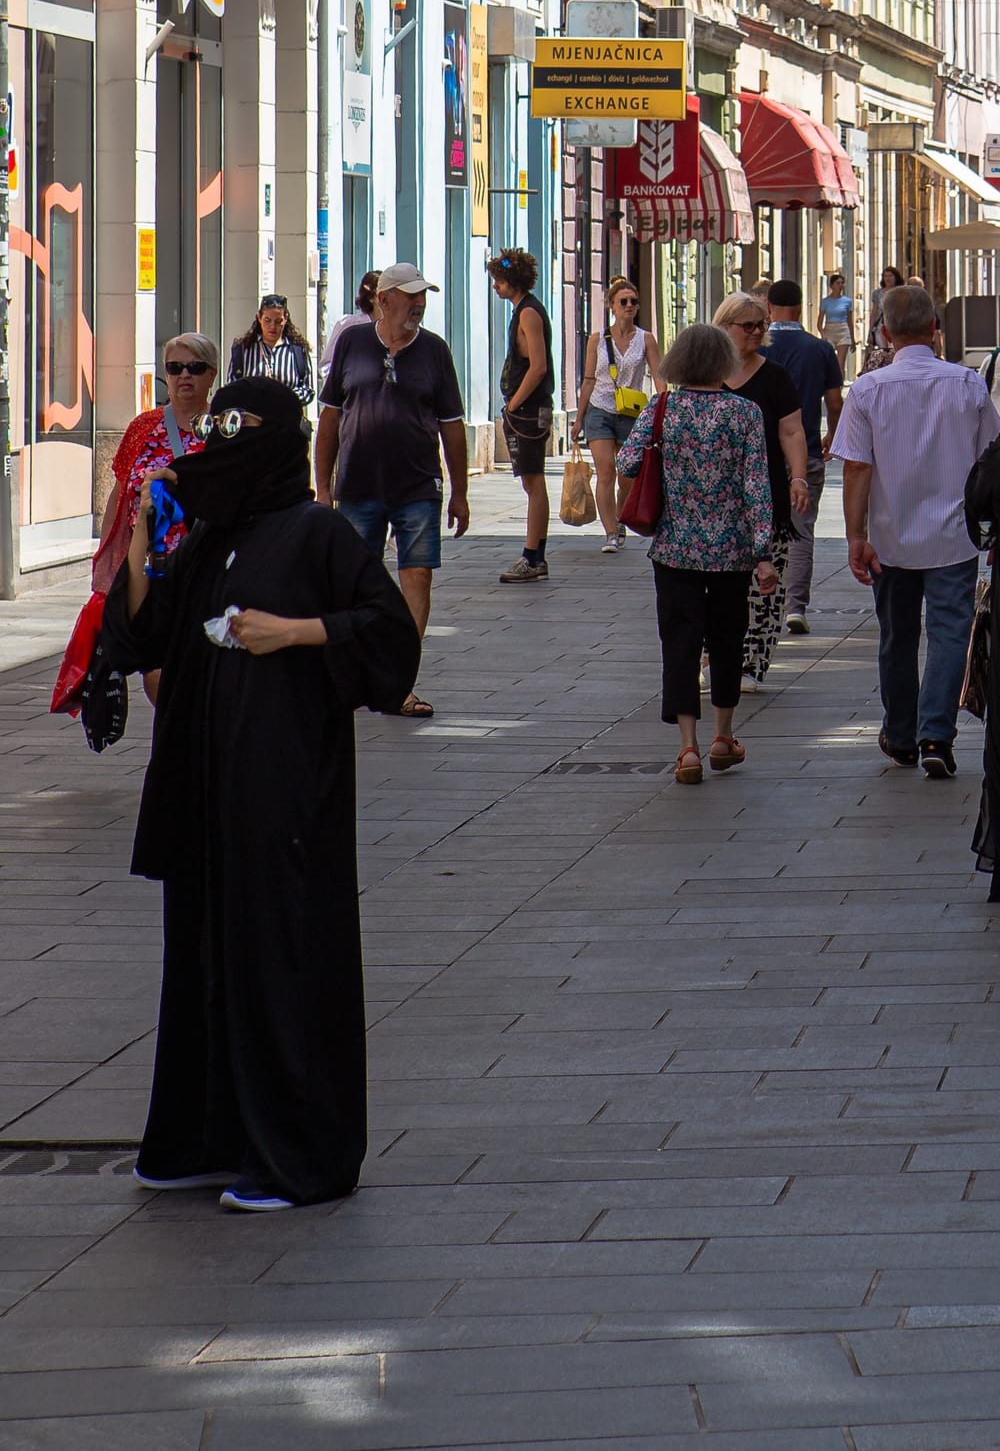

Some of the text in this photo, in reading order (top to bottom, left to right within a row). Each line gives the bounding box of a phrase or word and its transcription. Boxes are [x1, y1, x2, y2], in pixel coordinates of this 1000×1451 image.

[552, 43, 663, 61] MJENJAČNICA
[579, 74, 602, 83] cambio
[631, 75, 669, 84] geldwechsel
[565, 96, 649, 110] EXCHANGE
[623, 185, 691, 196] BANKOMAT
